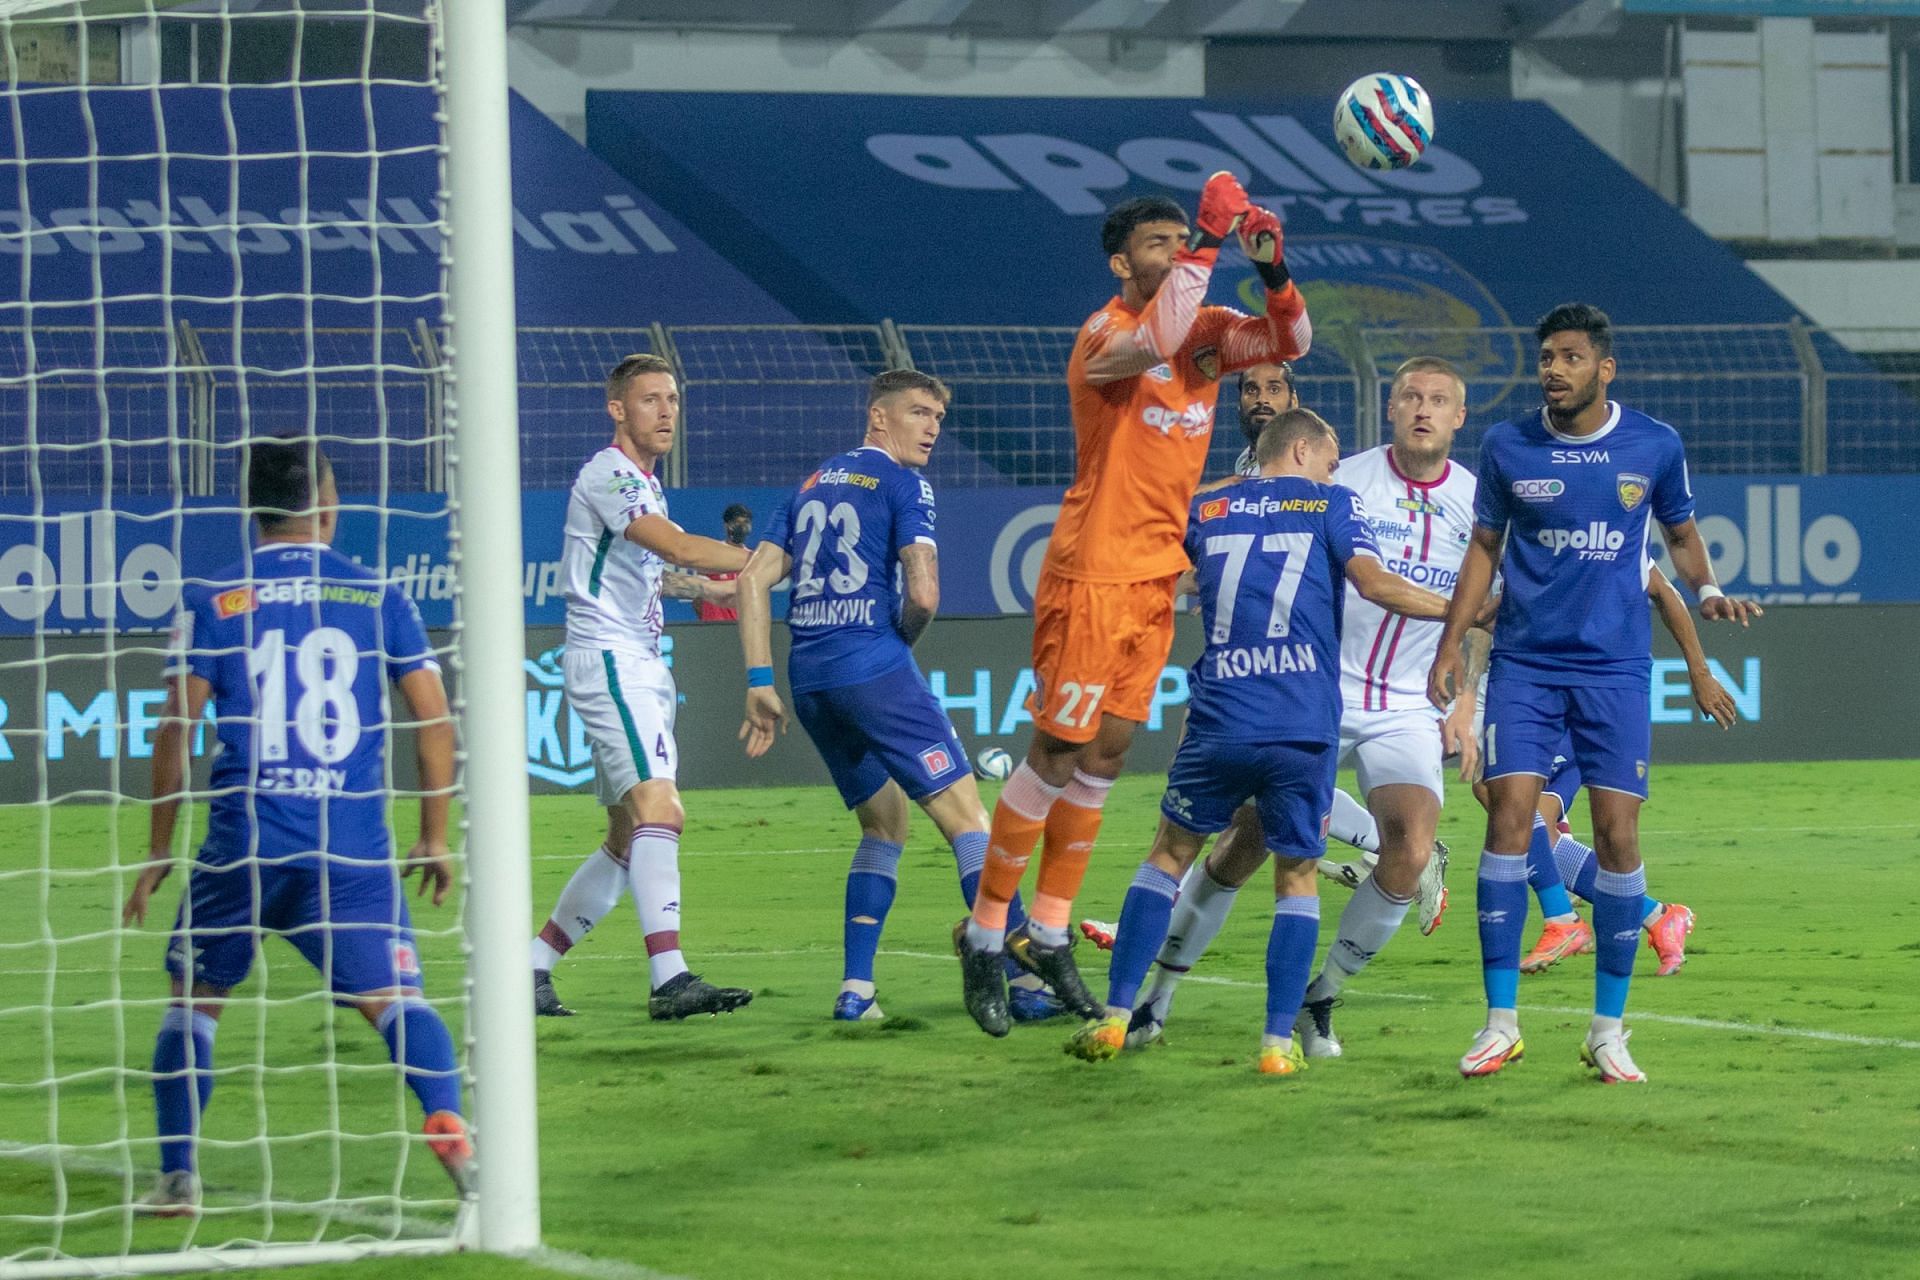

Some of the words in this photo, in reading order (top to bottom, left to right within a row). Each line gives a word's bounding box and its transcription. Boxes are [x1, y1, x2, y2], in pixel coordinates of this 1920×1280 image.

[866, 112, 1482, 215] apollo
[1247, 195, 1529, 226] TYRES
[1551, 450, 1610, 463] SSVM
[1229, 495, 1329, 518] dafaNEWS
[795, 499, 869, 600] 23
[1537, 521, 1625, 557] apollo
[1206, 532, 1314, 645] 77
[1216, 643, 1316, 680] KOMAN
[249, 626, 361, 764] 18
[1054, 681, 1106, 729] 27
[655, 732, 669, 766] 4
